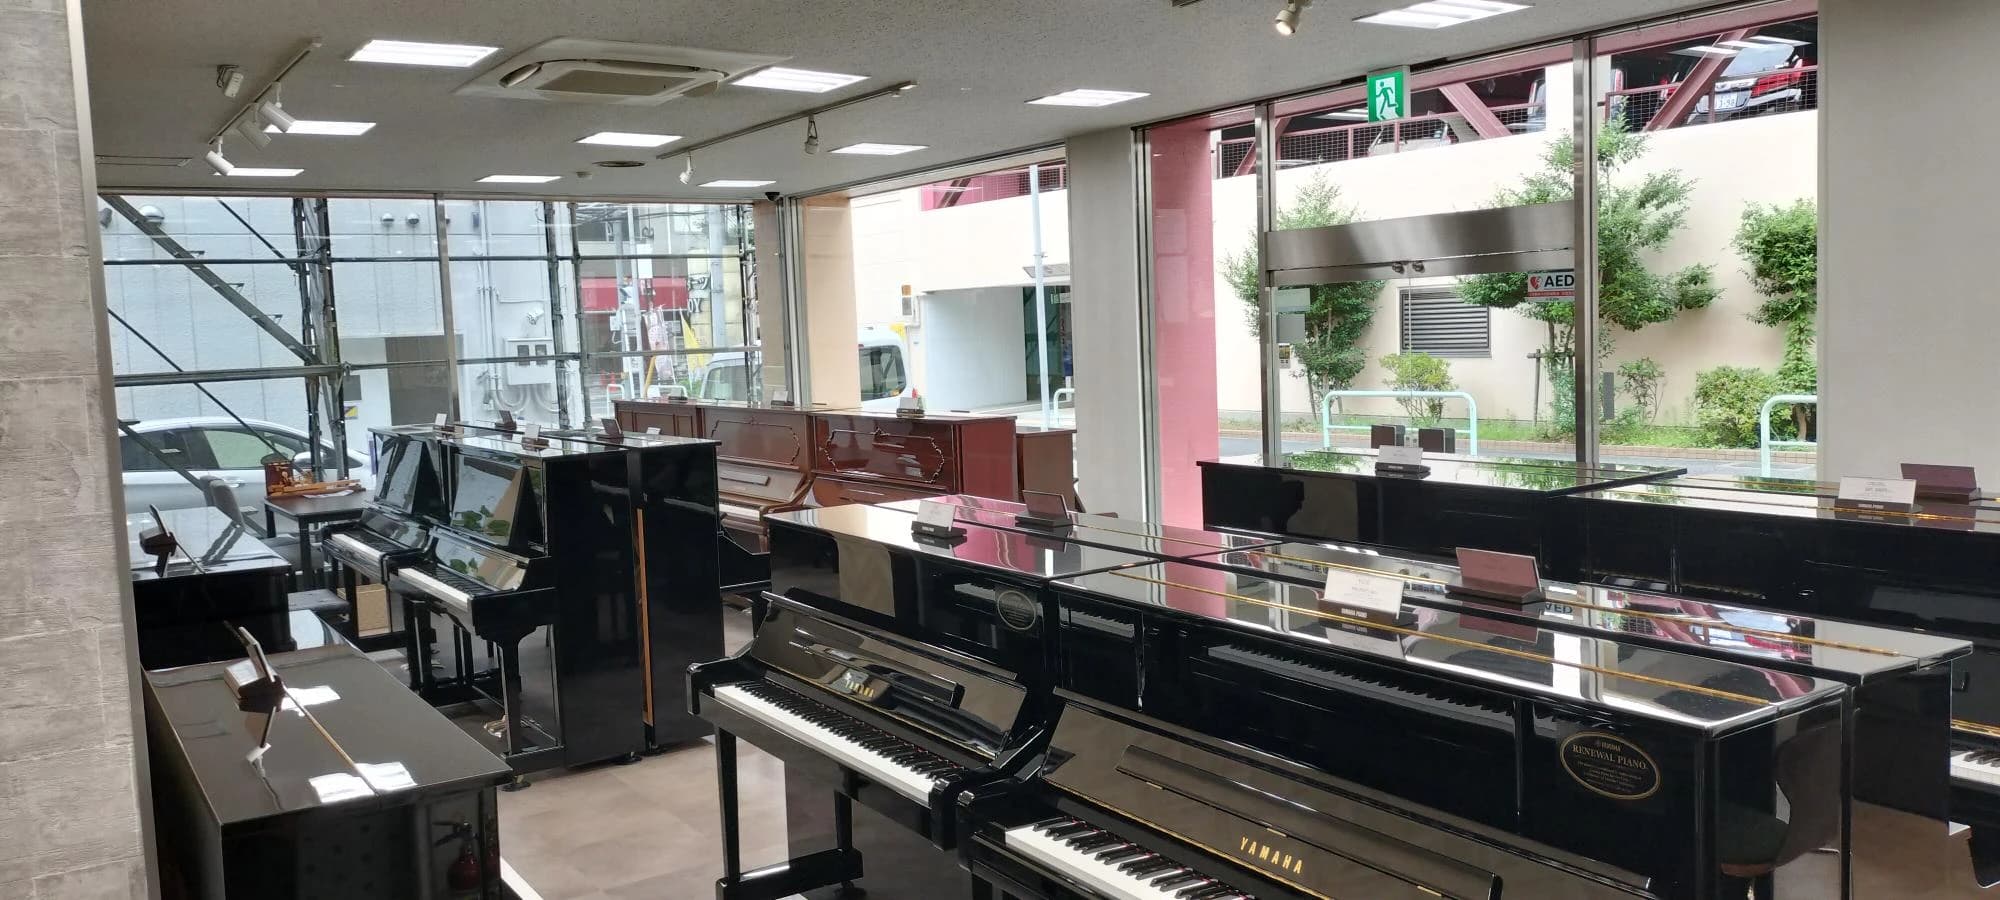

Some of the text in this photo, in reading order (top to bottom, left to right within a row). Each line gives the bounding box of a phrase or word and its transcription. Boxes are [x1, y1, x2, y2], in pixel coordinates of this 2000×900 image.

[1544, 274, 1575, 287] AED
[845, 678, 874, 698] YAMAHA
[1572, 744, 1647, 769] RENEWAL PIANO
[1240, 836, 1303, 874] YAMAHA
